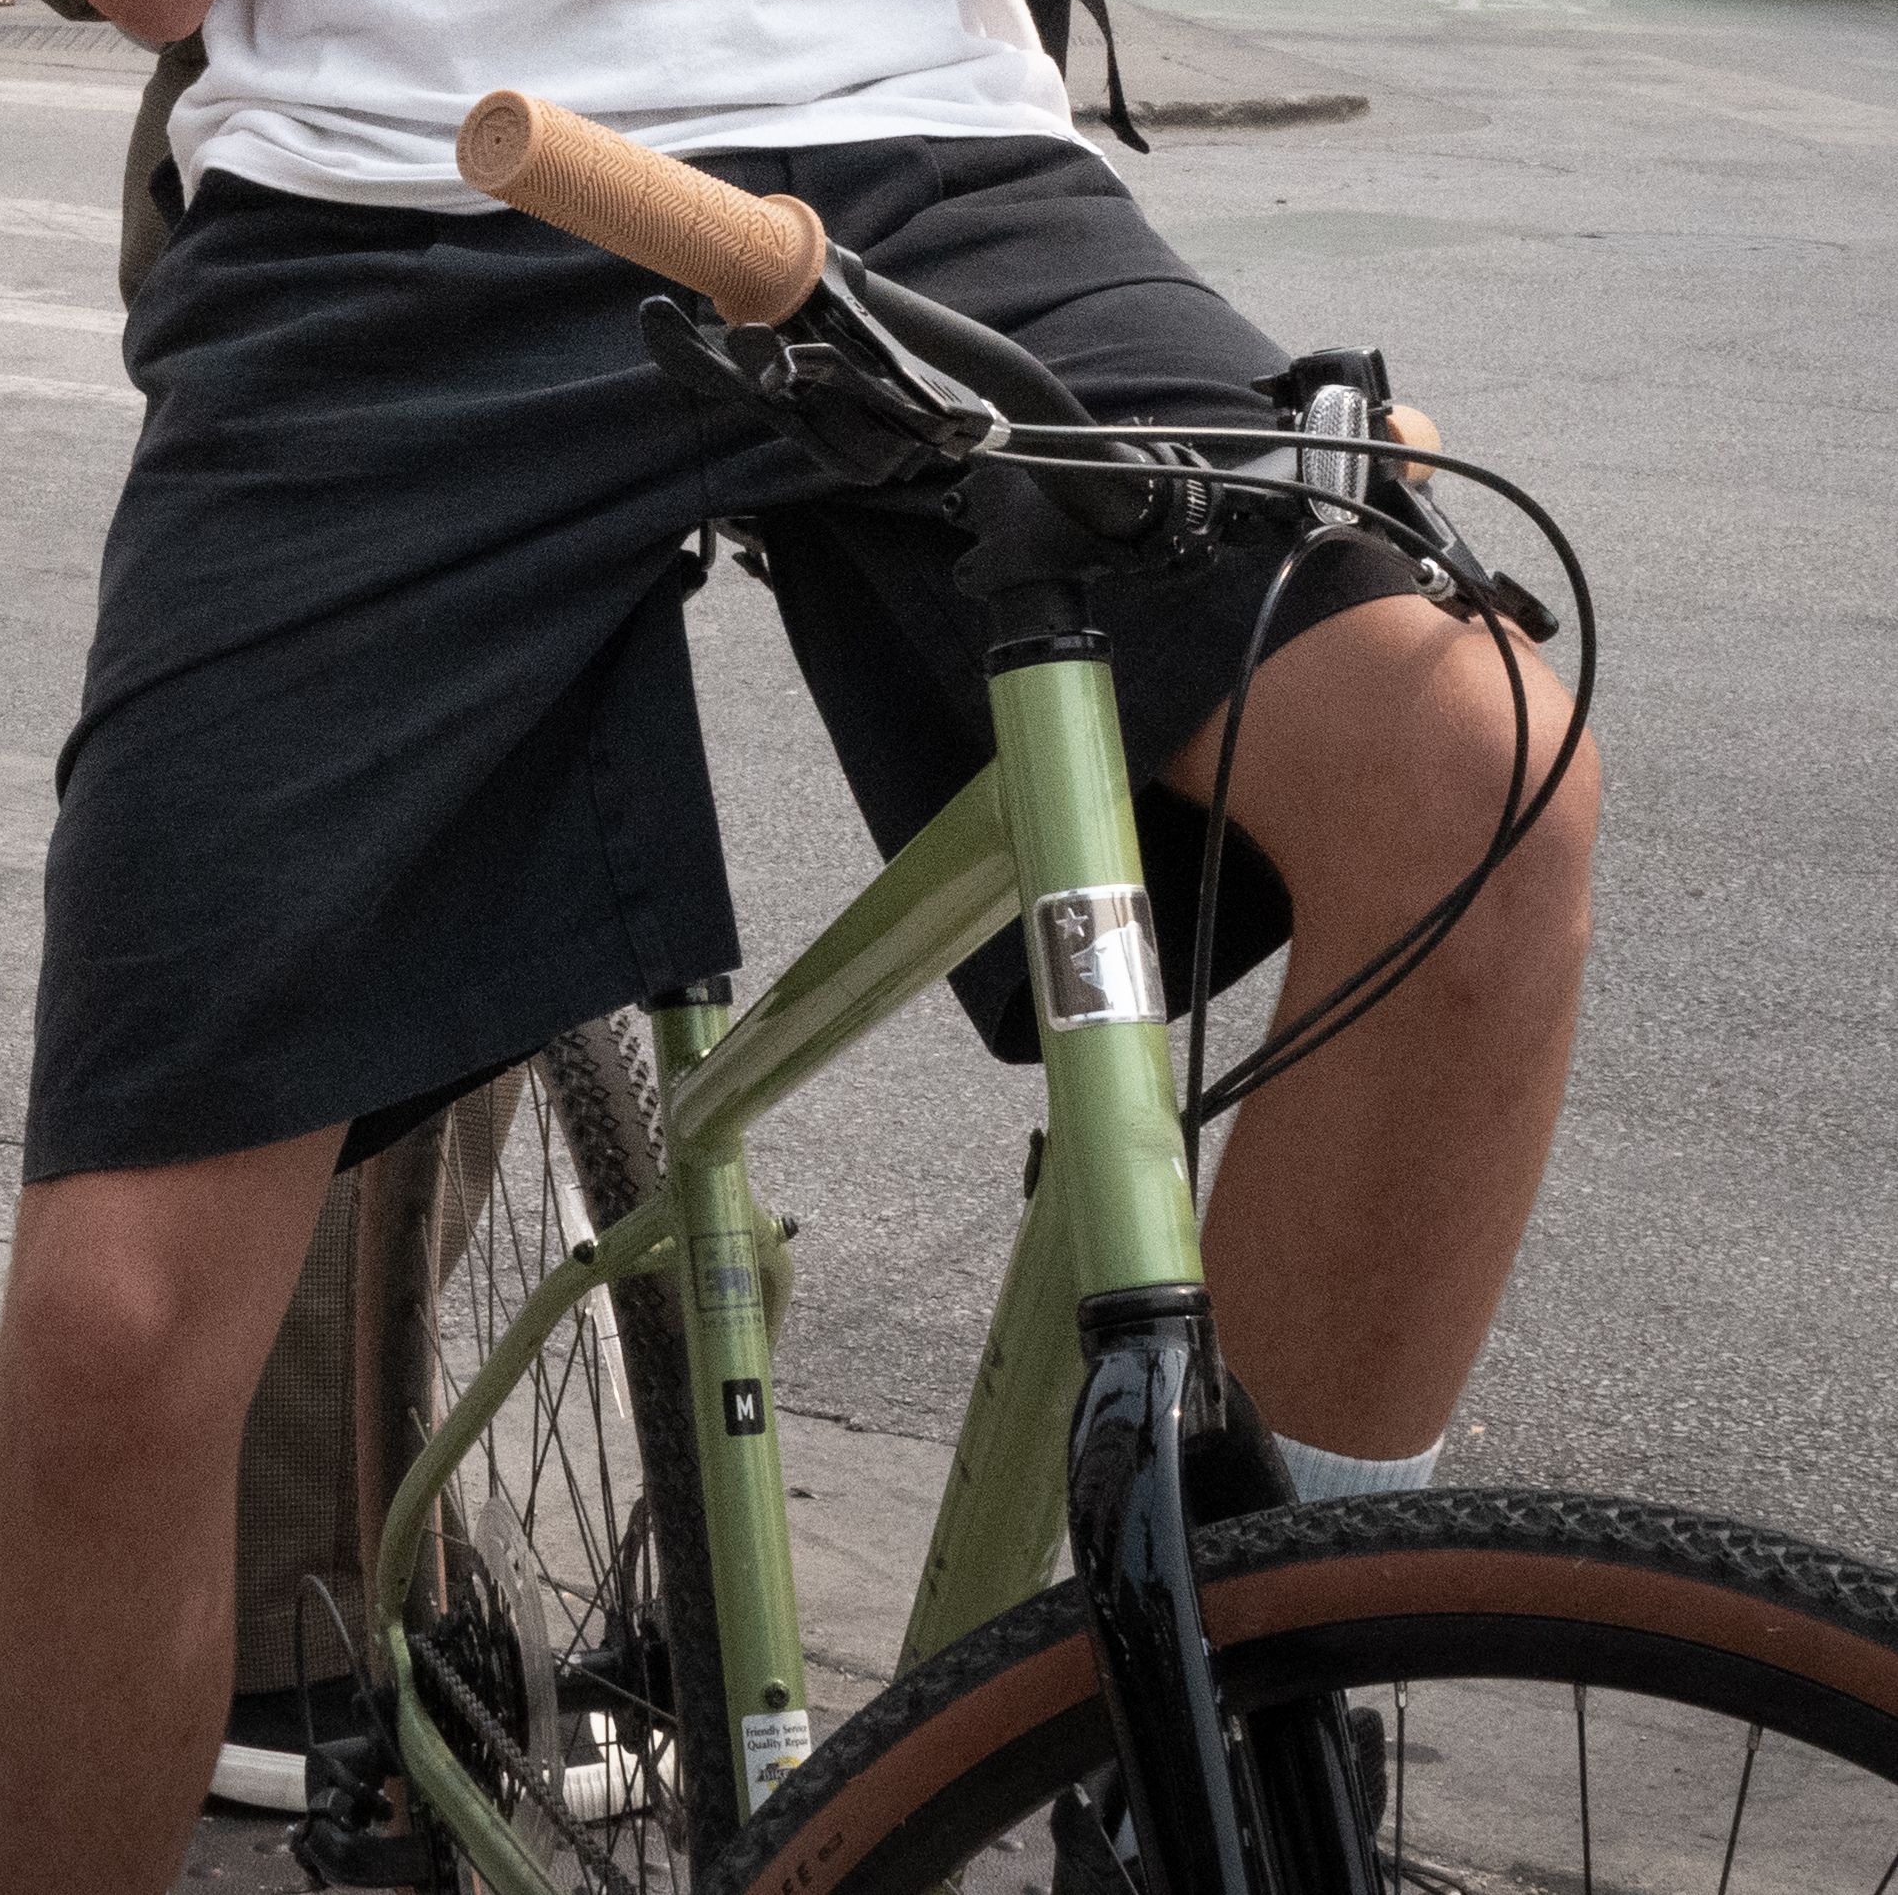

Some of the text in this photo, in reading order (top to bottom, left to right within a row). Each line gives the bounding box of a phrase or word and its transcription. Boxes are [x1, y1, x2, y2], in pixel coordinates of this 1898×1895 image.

[736, 1394, 756, 1422] M
[746, 1724, 807, 1737] Friendly Servic
[747, 1738, 782, 1752] Quality
